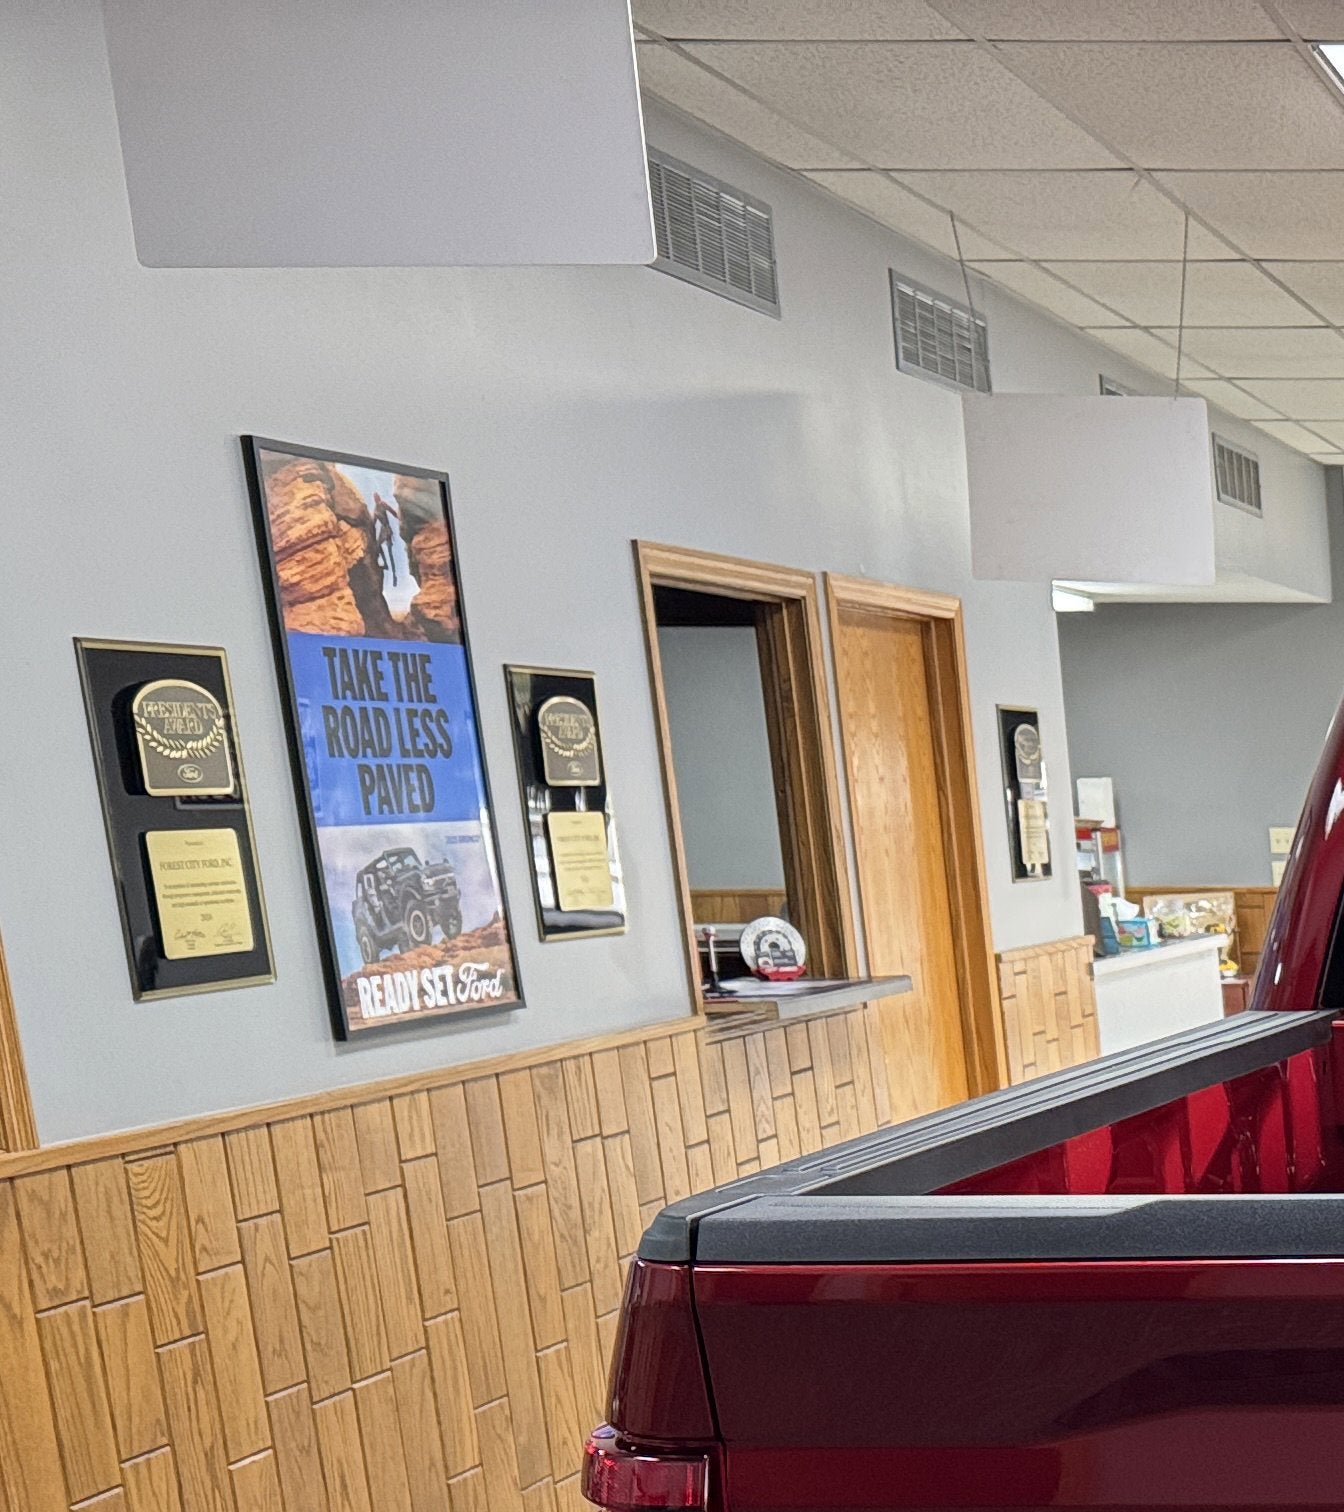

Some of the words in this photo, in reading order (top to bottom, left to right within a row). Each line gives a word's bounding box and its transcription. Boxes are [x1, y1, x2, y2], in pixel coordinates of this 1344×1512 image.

[321, 646, 389, 702] TAKE
[387, 651, 438, 704] THE
[321, 704, 393, 759] ROAD
[393, 707, 453, 759] LESS
[356, 763, 435, 816] PAVED
[357, 970, 421, 1019] READY
[421, 965, 458, 1009] SET
[456, 961, 506, 1003] Ford
